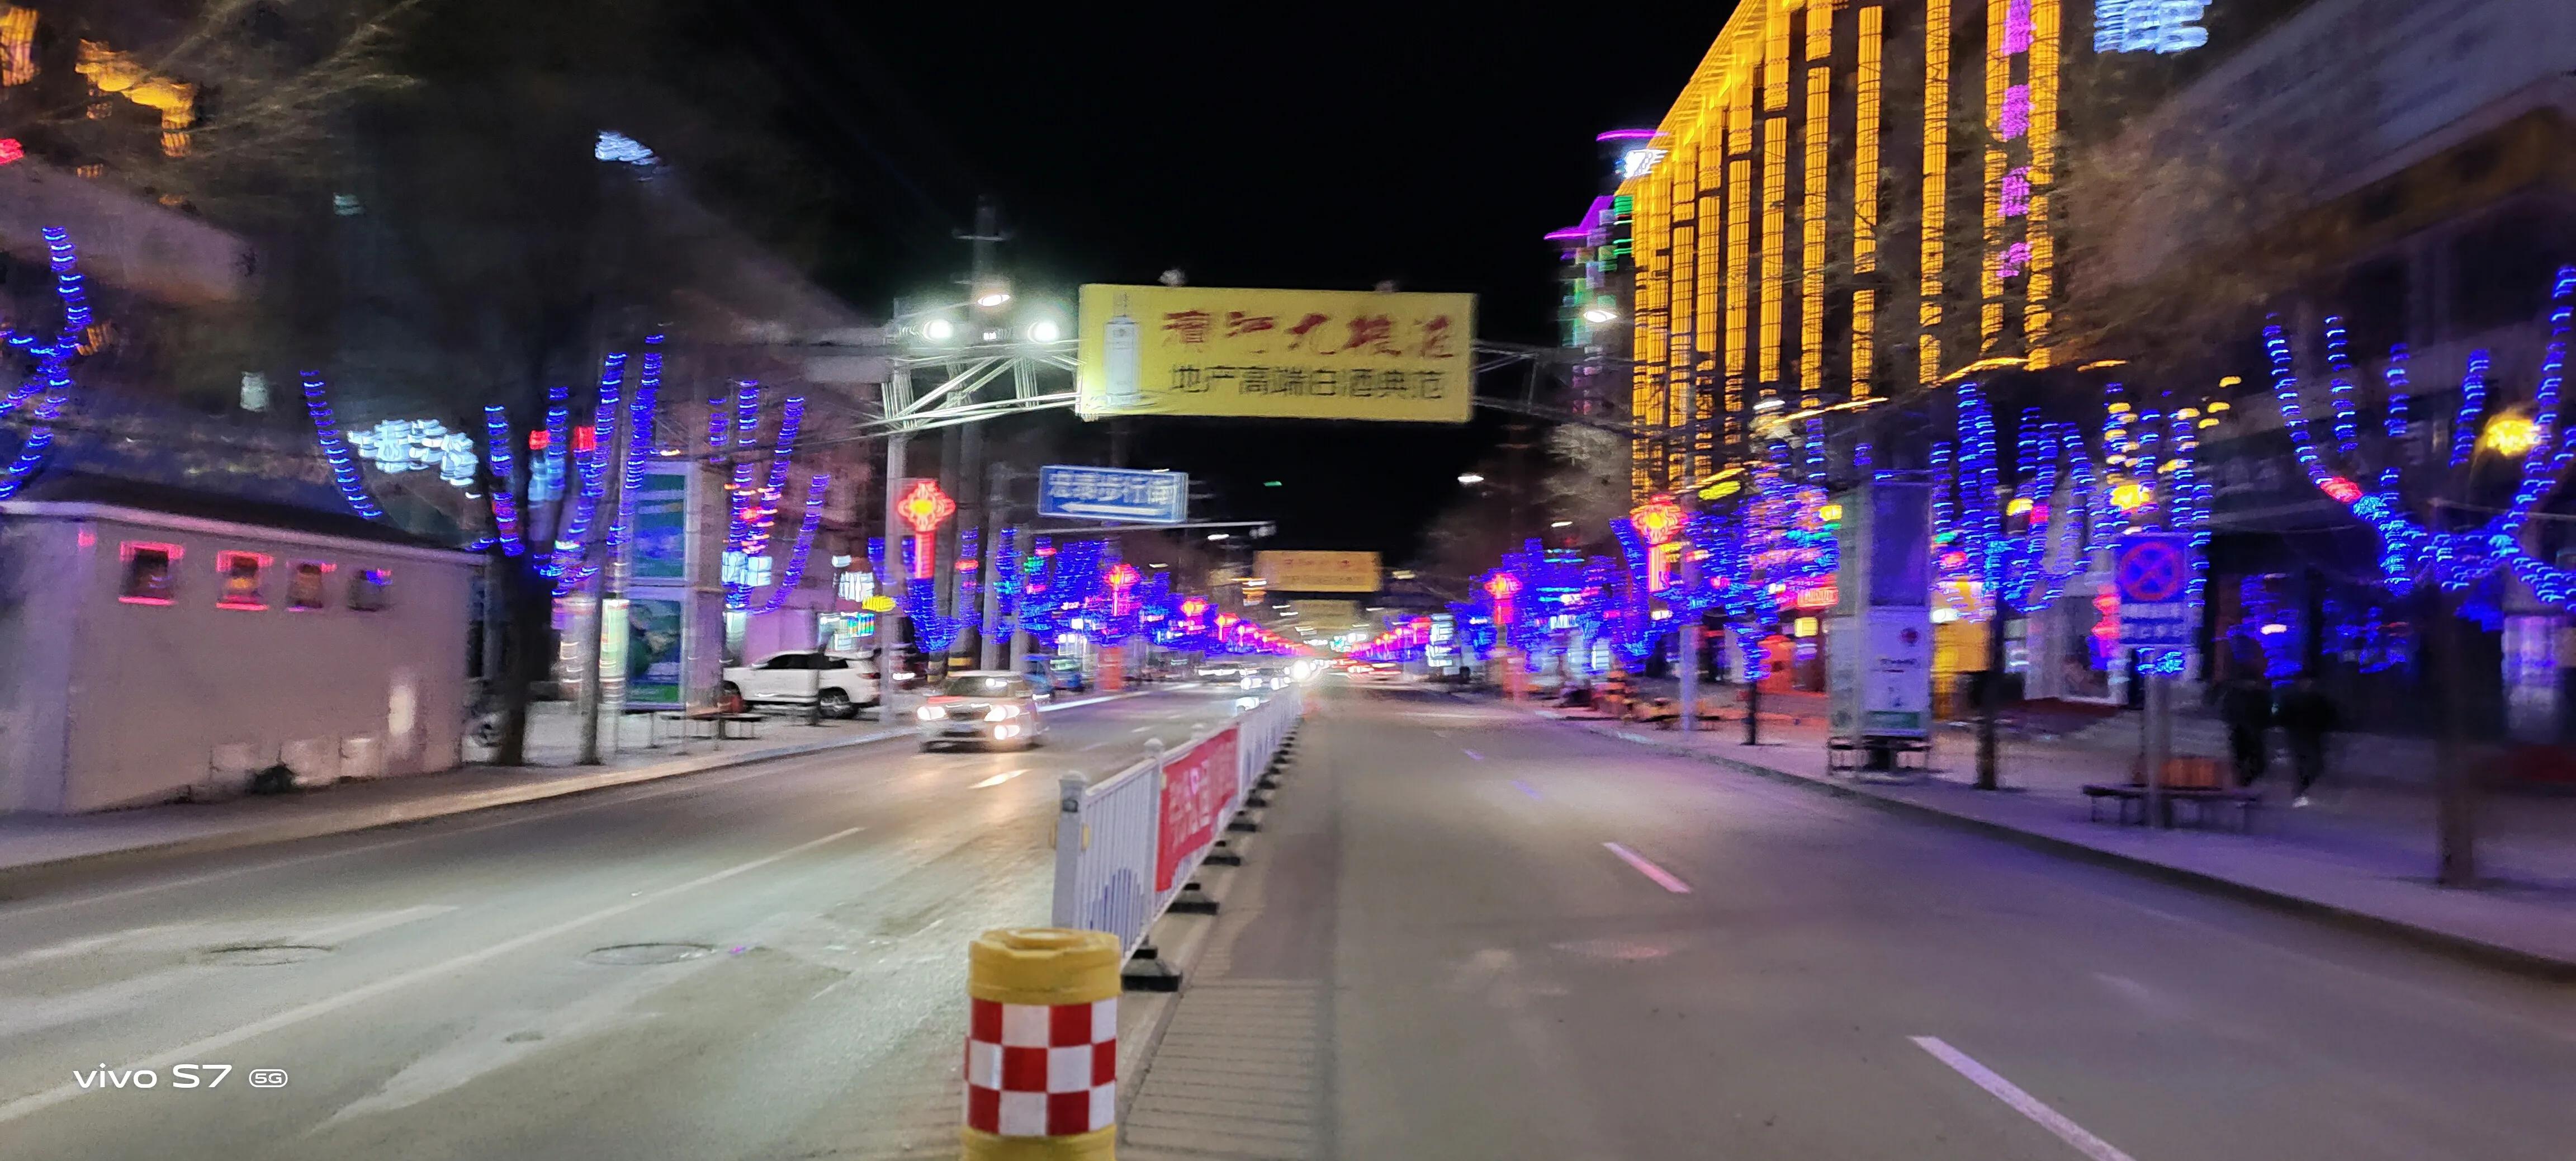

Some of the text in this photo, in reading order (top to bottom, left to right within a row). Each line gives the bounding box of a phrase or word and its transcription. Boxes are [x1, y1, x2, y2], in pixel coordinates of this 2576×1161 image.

[1169, 364, 1448, 399] 地产高端白酒典范
